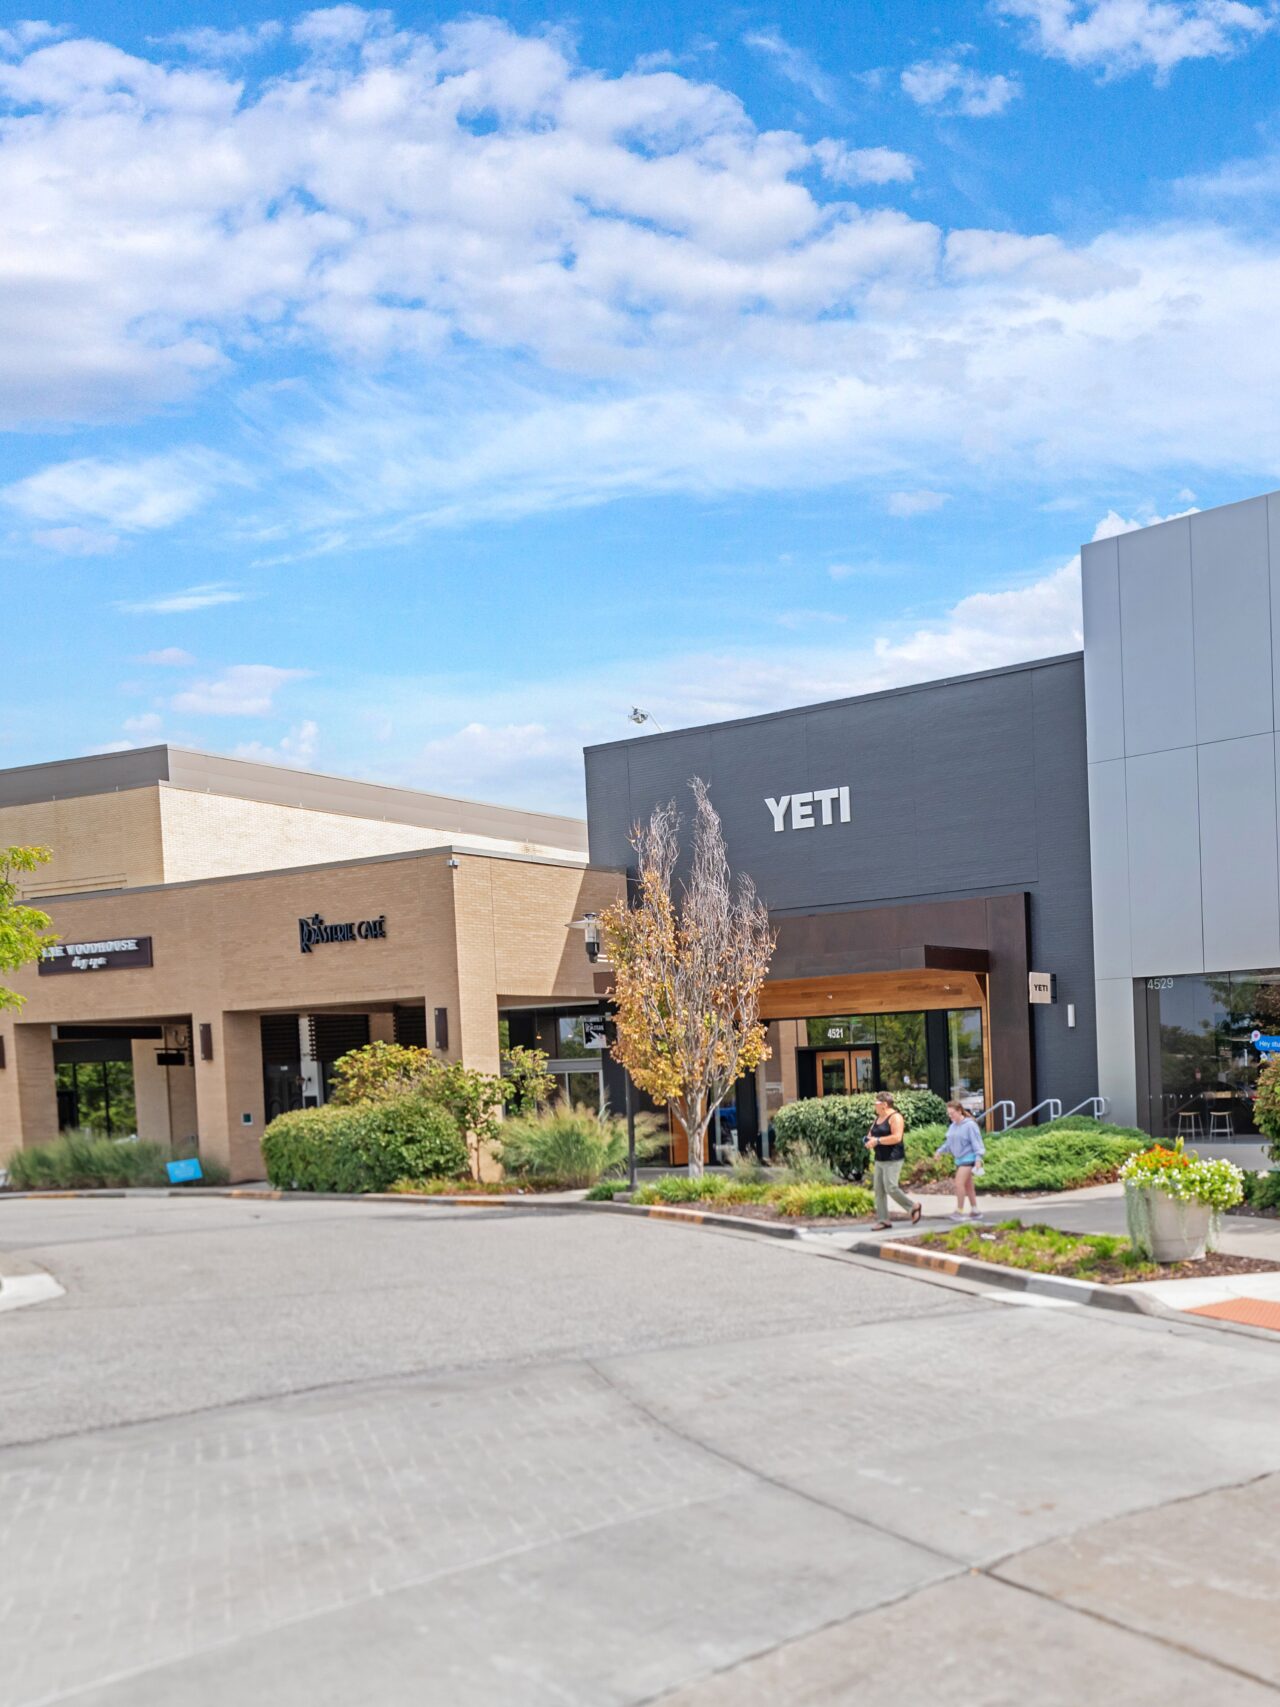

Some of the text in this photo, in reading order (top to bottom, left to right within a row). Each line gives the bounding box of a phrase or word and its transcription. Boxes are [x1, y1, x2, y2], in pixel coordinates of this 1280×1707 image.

[764, 786, 851, 832] YETI
[65, 939, 139, 956] WOODHOUSE
[1033, 983, 1049, 992] YETI
[1147, 977, 1174, 990] 4529
[827, 1027, 844, 1039] 4521
[1258, 1040, 1271, 1049] Hey
